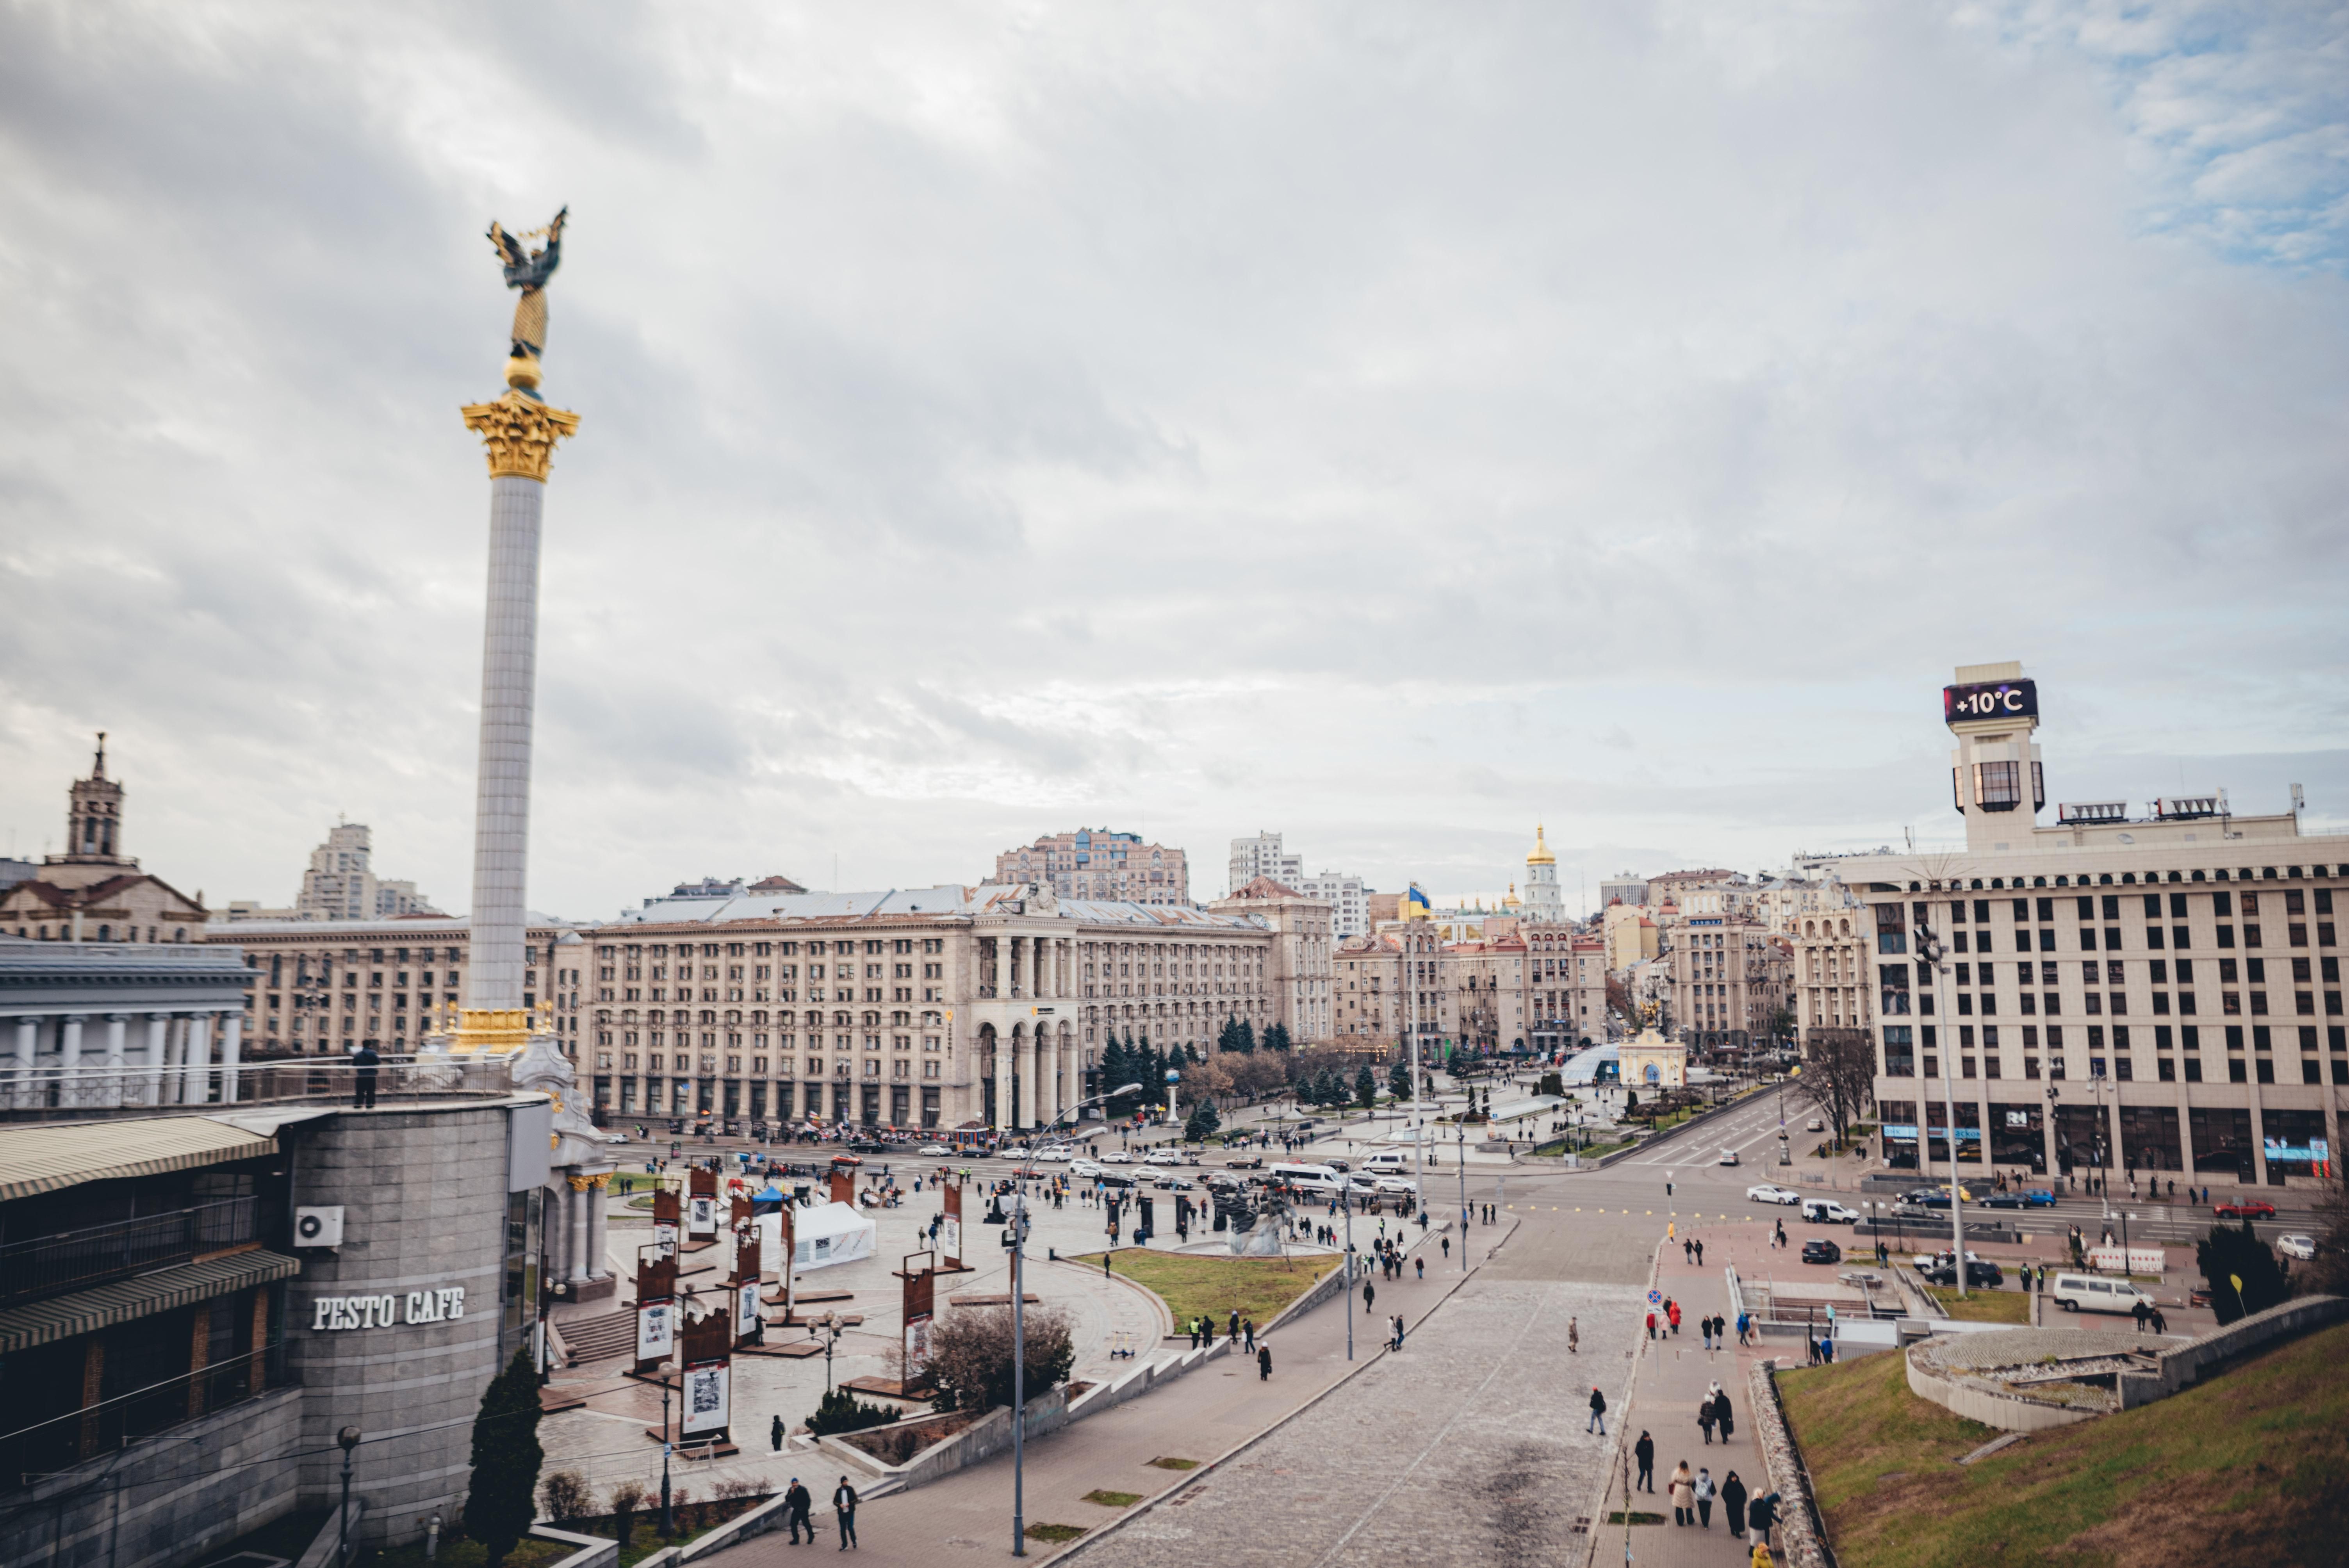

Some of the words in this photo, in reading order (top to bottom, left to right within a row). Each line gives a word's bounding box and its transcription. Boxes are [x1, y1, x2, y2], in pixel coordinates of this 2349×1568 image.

[1956, 690, 2023, 714] +10°C
[312, 1294, 395, 1330] PESTO
[405, 1286, 465, 1325] CAFE
